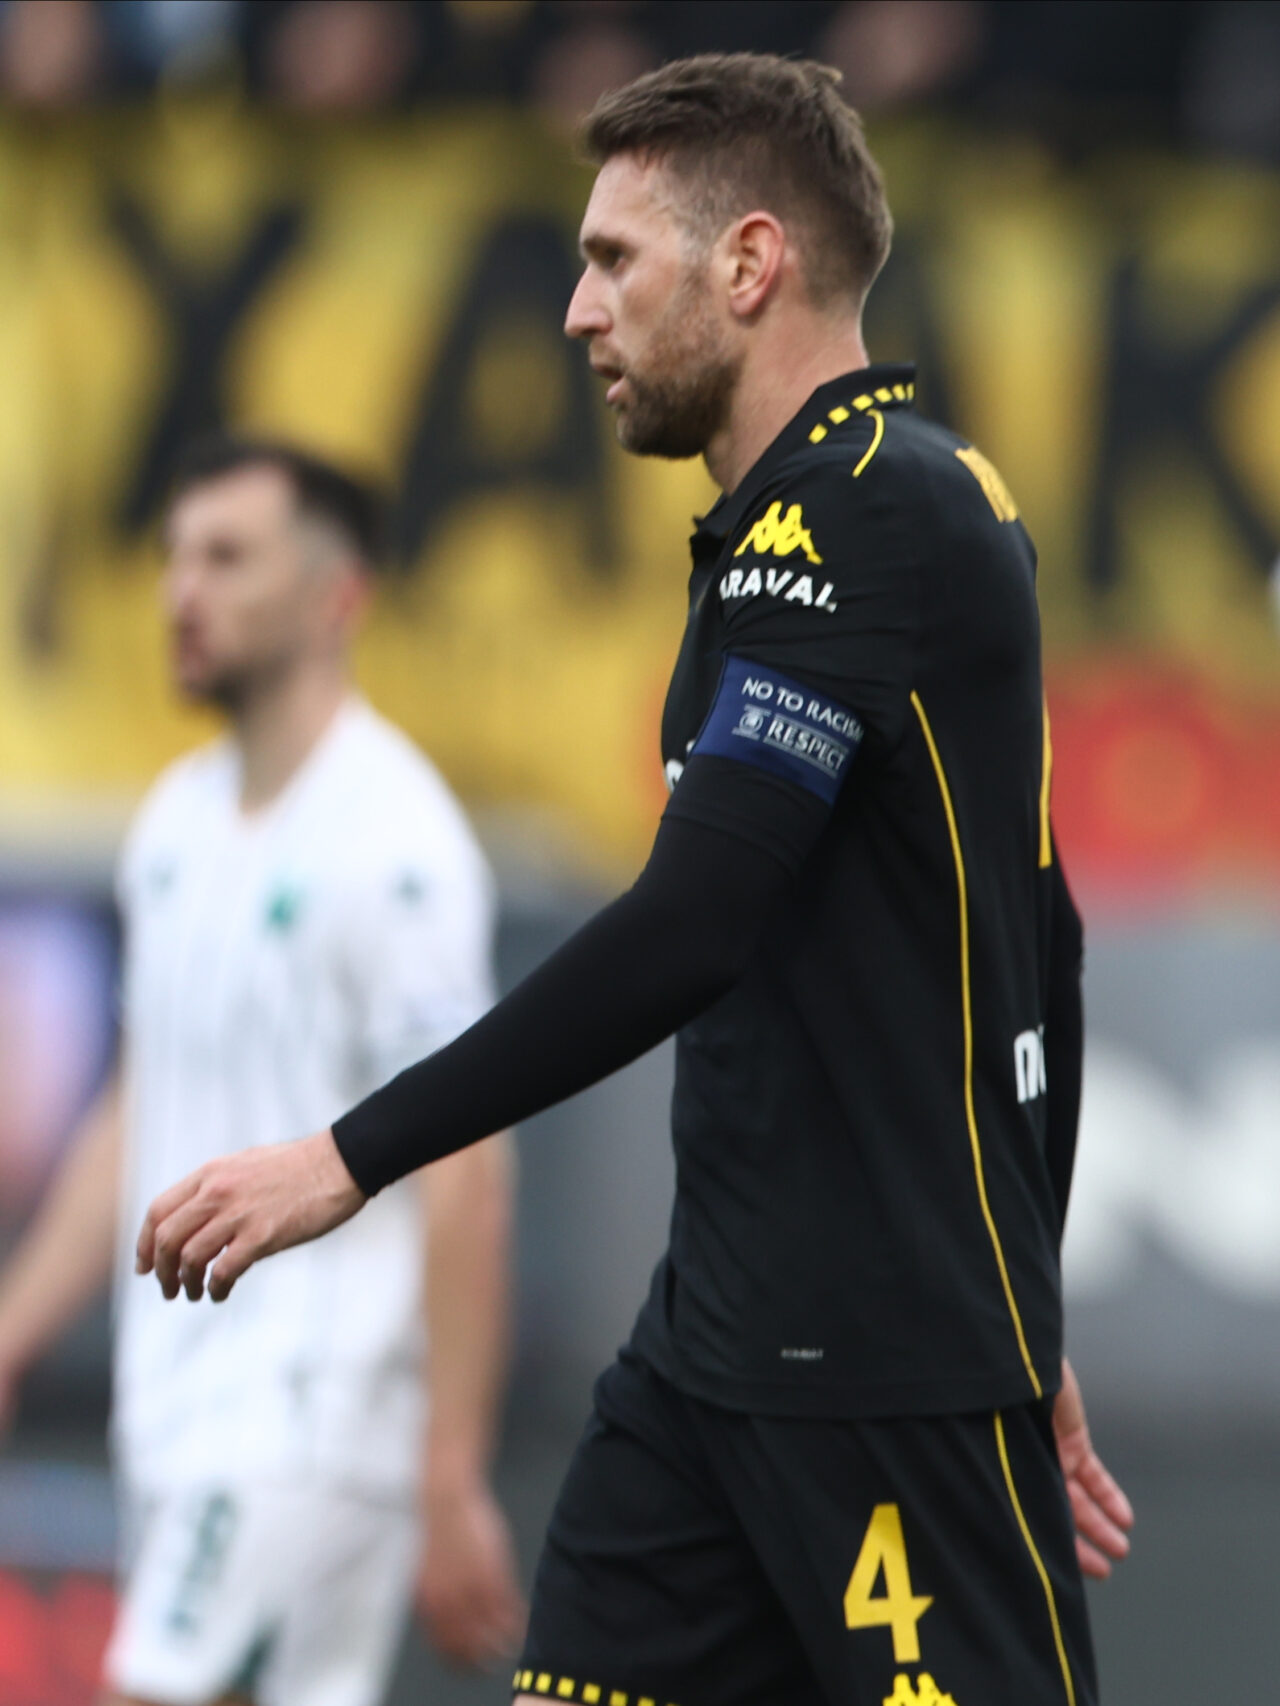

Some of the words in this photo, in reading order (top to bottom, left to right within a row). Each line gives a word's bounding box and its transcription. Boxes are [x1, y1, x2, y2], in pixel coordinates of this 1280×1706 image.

[741, 676, 774, 701] NO
[776, 686, 804, 712] TO
[767, 718, 845, 770] RESPECT
[844, 1503, 934, 1663] 4
